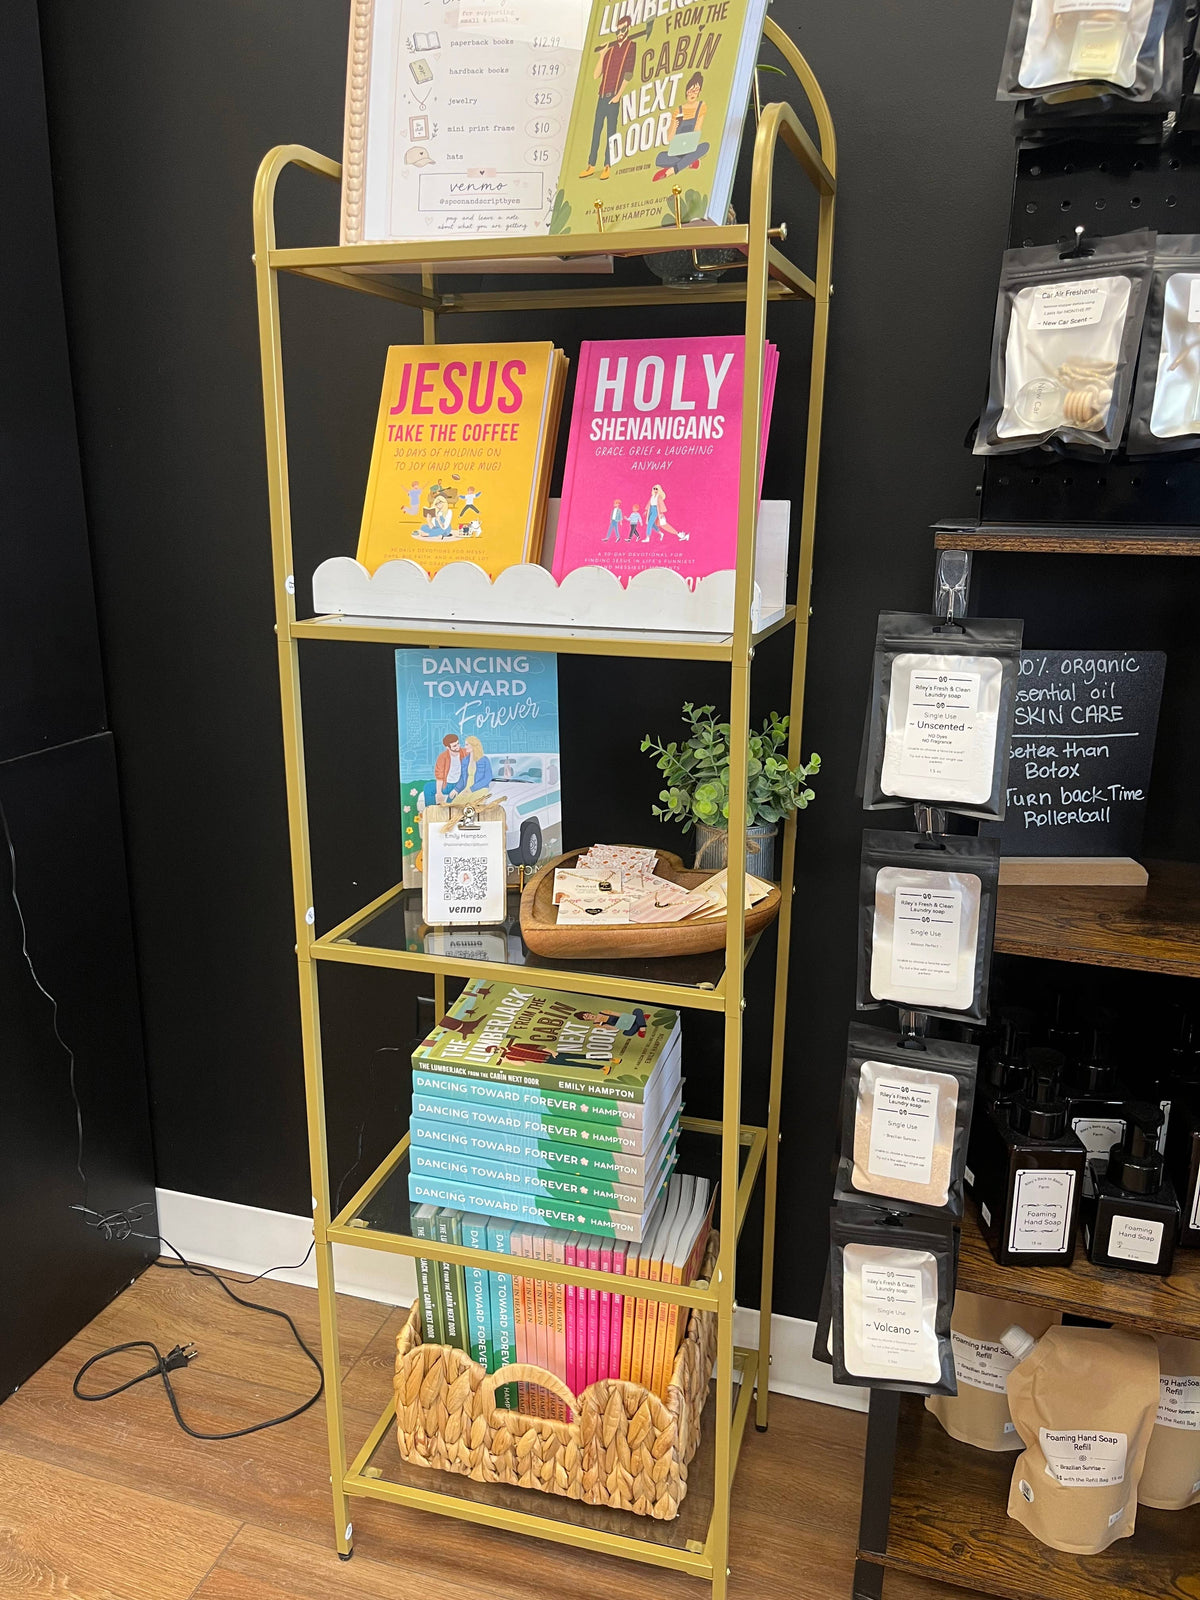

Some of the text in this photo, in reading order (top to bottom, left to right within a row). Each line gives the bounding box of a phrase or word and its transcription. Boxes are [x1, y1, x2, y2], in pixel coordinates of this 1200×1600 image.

[666, 1, 729, 34] FROM THE
[450, 36, 560, 48] paperback books $12.99
[641, 32, 722, 83] CABIN
[532, 64, 560, 76] $17.99
[447, 92, 552, 106] jewelry $25
[622, 73, 683, 125] NEXT
[468, 125, 490, 133] print
[493, 124, 515, 132] frame
[534, 122, 550, 134] $10
[608, 112, 672, 167] DOOR
[533, 150, 549, 162] $15
[450, 181, 508, 192] venmo
[631, 198, 653, 208] SELLING
[622, 207, 663, 220] HAMPTON
[1066, 288, 1099, 296] Freshener
[390, 360, 527, 415] JESUS
[594, 352, 734, 412] HOLY
[388, 423, 520, 442] TAKE THE COFFEE
[590, 416, 725, 441] SHENANIGANS
[394, 448, 502, 458] 30 DAYS OF HOLDING ON
[628, 445, 654, 456] GRIEF
[664, 444, 714, 456] LAUGHING
[395, 461, 502, 472] TO JOY (AND YOUR MUG)
[632, 461, 672, 470] ANYWAY
[422, 656, 530, 675] DANCING
[424, 680, 528, 698] TOWARD
[1090, 682, 1115, 699] oil
[455, 696, 540, 735] Forever
[924, 712, 944, 720] Single
[1015, 704, 1124, 726] SKIN CARE
[917, 720, 964, 732] Unscented
[1062, 742, 1110, 758] than
[1025, 761, 1080, 780] Botox
[1060, 786, 1108, 805] back
[1108, 784, 1145, 801] Time
[1024, 806, 1110, 829] Rollerball
[448, 906, 482, 914] venmo
[514, 997, 546, 1030] FROM THE
[530, 1001, 577, 1042] CABIN
[464, 987, 534, 1064] LUMBERJACK
[556, 1020, 590, 1052] NEXT
[586, 1027, 620, 1060] DOOR
[440, 1038, 472, 1059] THE
[418, 1062, 430, 1070] THE
[430, 1063, 467, 1076] LUMBERJACK
[490, 1072, 507, 1082] CABIN
[508, 1075, 523, 1084] NEXT
[523, 1077, 540, 1086] DOOR
[558, 1081, 586, 1091] EMILY
[588, 1085, 634, 1098] HAMPTON
[416, 1078, 636, 1120] DANCING TOWARD FOREVER HAMPTON
[418, 1104, 636, 1146] DANCING TOWARD FOREVER HAMPTON
[888, 1120, 906, 1129] Single
[416, 1128, 638, 1174] DANCING TOWARD FOREVER HAMPTON
[416, 1157, 637, 1204] DANCING TOWARD FOREVER HAMPTON
[415, 1186, 634, 1232] DANCING TOWARD FOREVER HAMPTON
[1027, 1210, 1057, 1218] Foaming
[1024, 1218, 1042, 1226] Hand
[1124, 1224, 1153, 1234] Foaming
[1118, 1231, 1155, 1242] Hand Soap
[424, 1293, 435, 1310] CABIN
[446, 1291, 456, 1308] CABIN
[474, 1280, 484, 1323] TOWARD
[426, 1310, 434, 1323] NEXT
[447, 1308, 456, 1321] NEXT
[498, 1284, 510, 1368] TOWARD FOREVE
[874, 1322, 911, 1335] Volcano
[952, 1334, 999, 1353] Foaming Hand
[976, 1352, 992, 1360] Refill
[1046, 1433, 1118, 1445] Foaming Hand Soap
